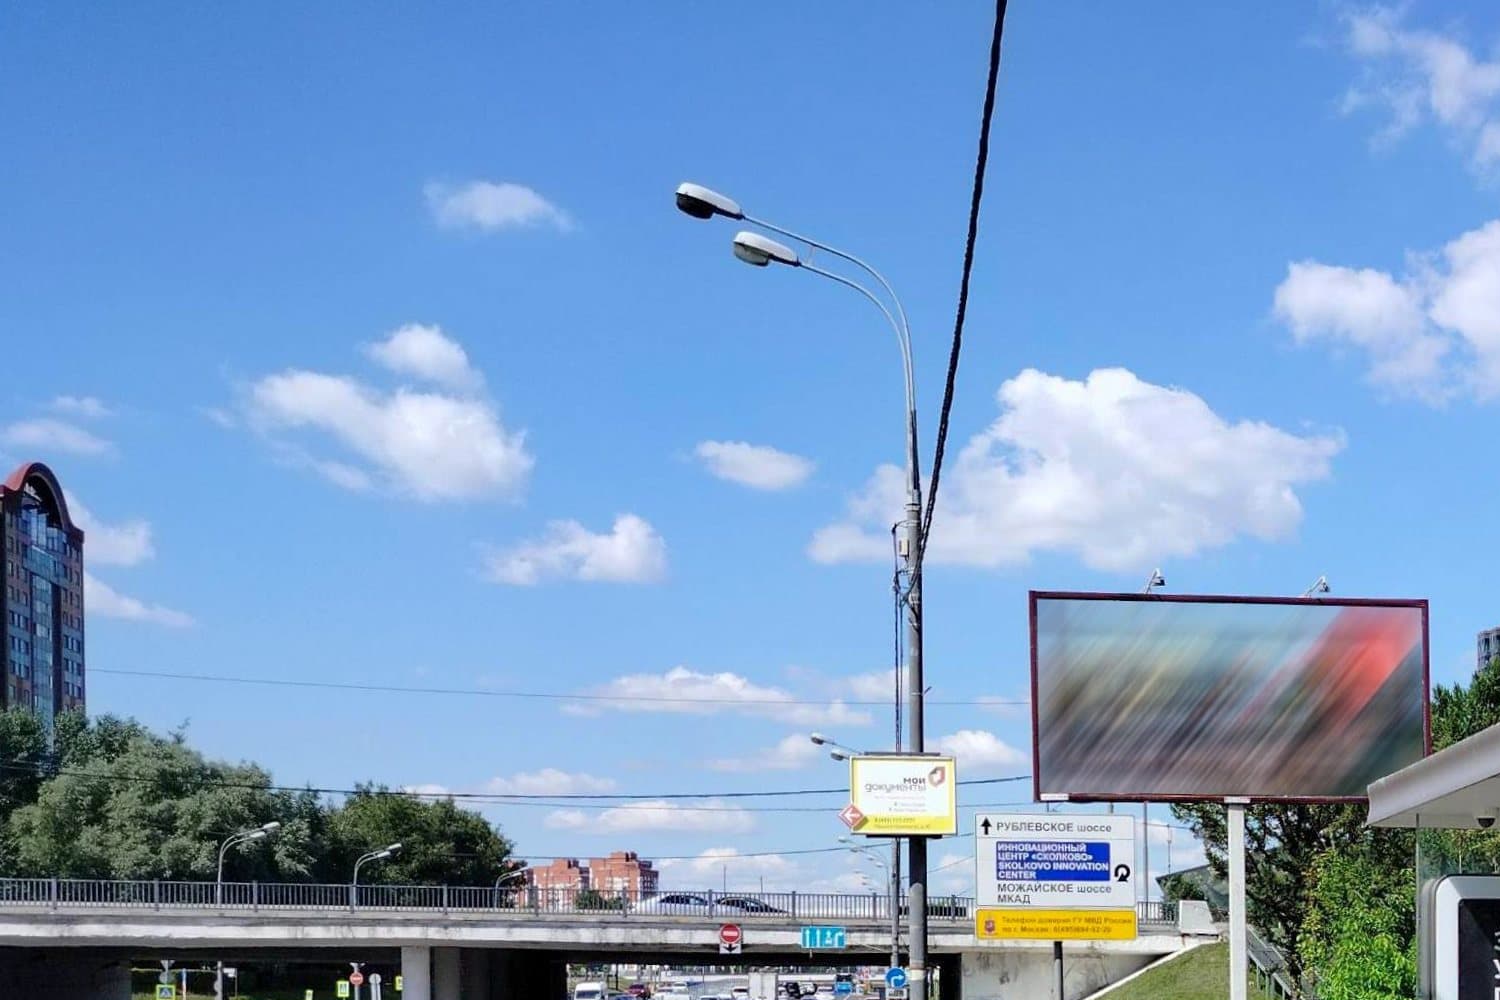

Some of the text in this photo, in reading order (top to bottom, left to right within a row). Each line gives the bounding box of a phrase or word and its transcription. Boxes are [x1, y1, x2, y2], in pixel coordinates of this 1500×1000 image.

[996, 821, 1112, 833] РУБЛЕВСКОЕ шоссе
[997, 843, 1087, 852] ИННОВАЦИОННЫЙ
[998, 853, 1029, 861] ЦЕНТР
[998, 862, 1109, 871] SKOLKOVO INNOVATION
[998, 871, 1036, 879] CENTER
[997, 882, 1112, 893] МОЖАЙСКОЕ шоссе
[997, 895, 1031, 904] МКАД
